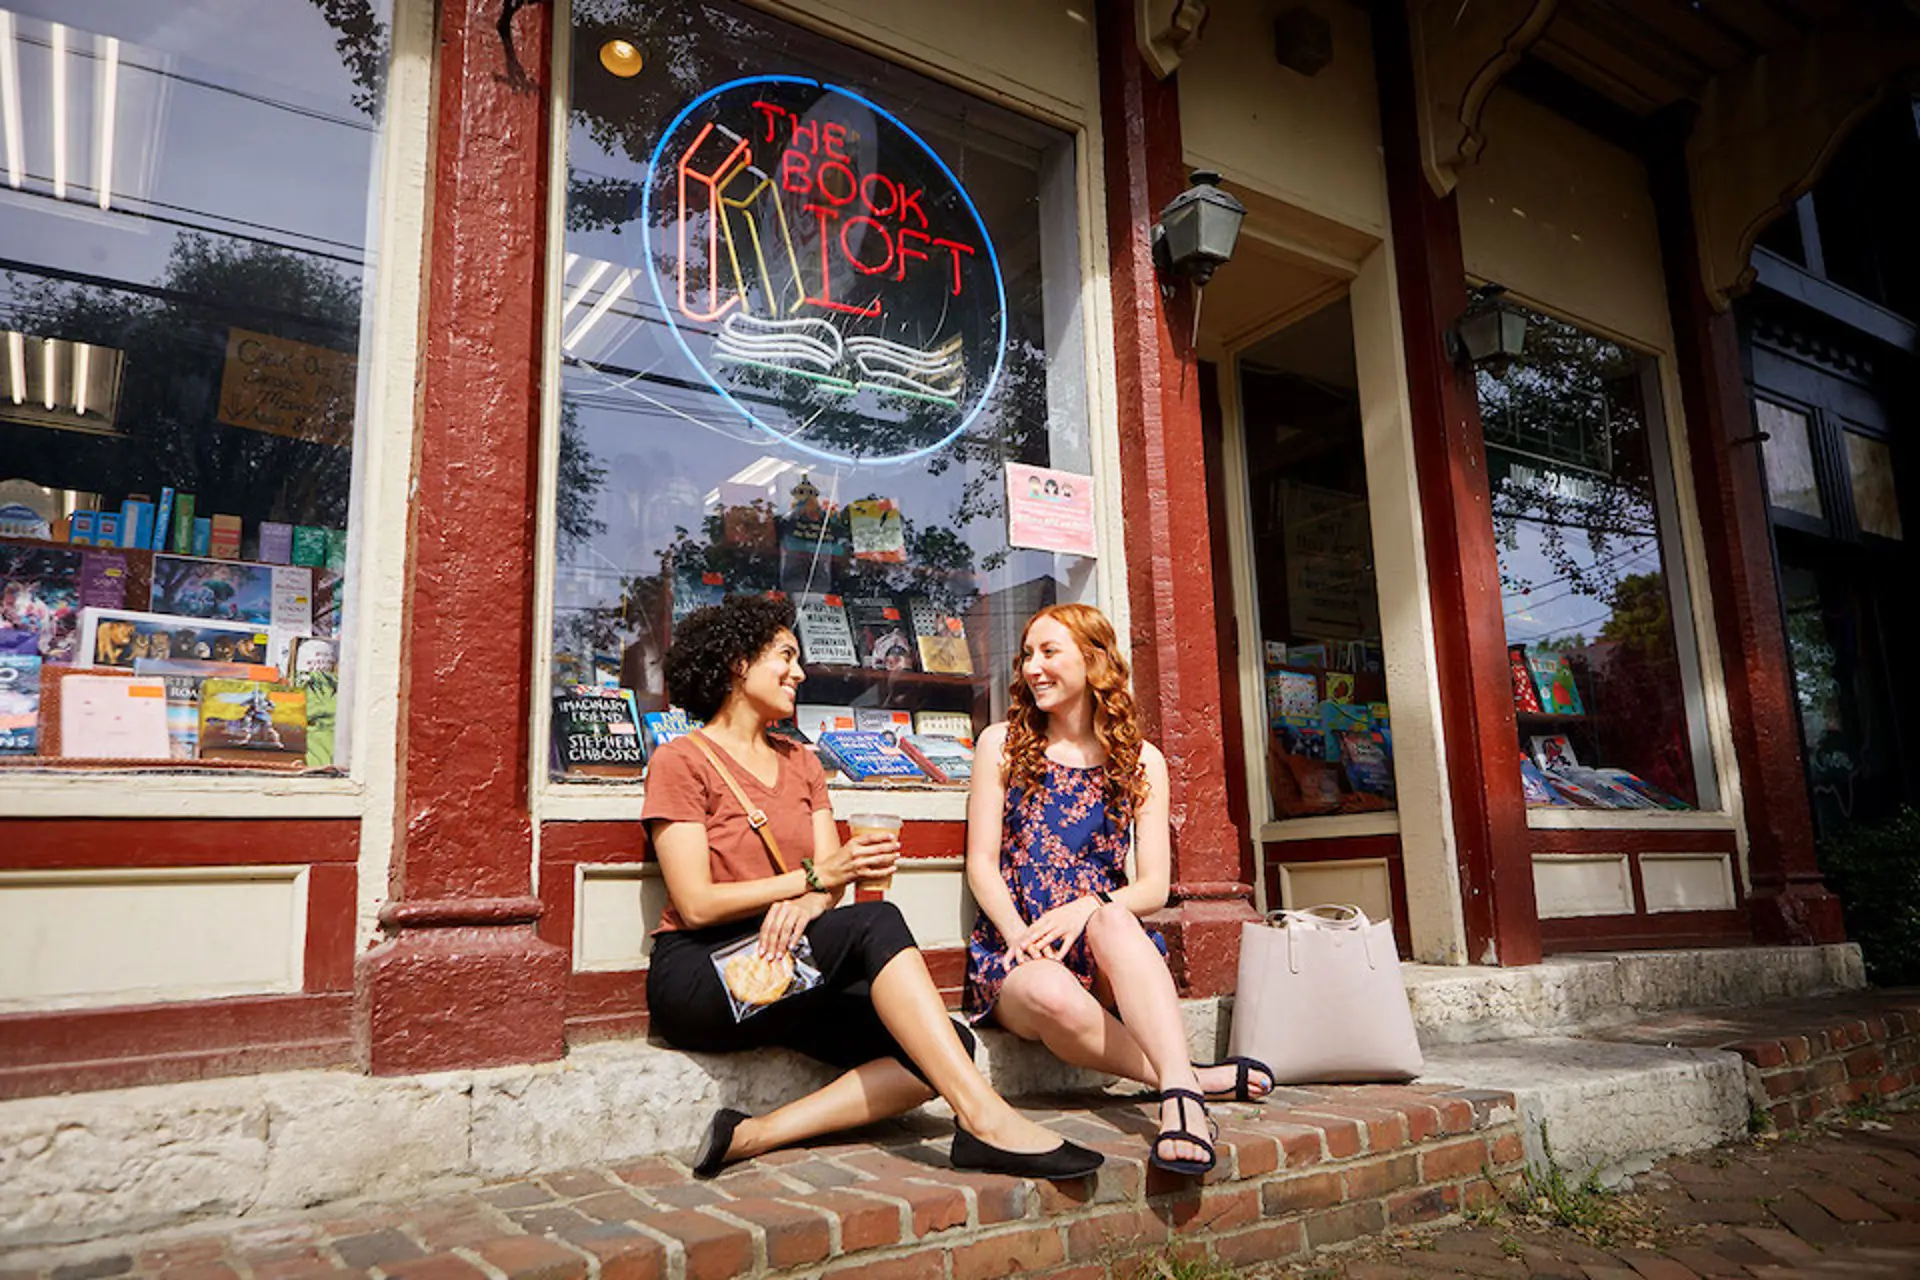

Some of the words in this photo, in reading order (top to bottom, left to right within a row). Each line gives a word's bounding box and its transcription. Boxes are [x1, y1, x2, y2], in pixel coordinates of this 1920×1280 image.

[752, 101, 852, 164] THE
[782, 150, 929, 228] BOOK
[802, 203, 975, 317] LOFT
[558, 698, 627, 713] IMAGINARY
[571, 711, 623, 723] FRIEND
[568, 733, 637, 750] STEPHEN
[567, 748, 641, 762] CHBOSKY
